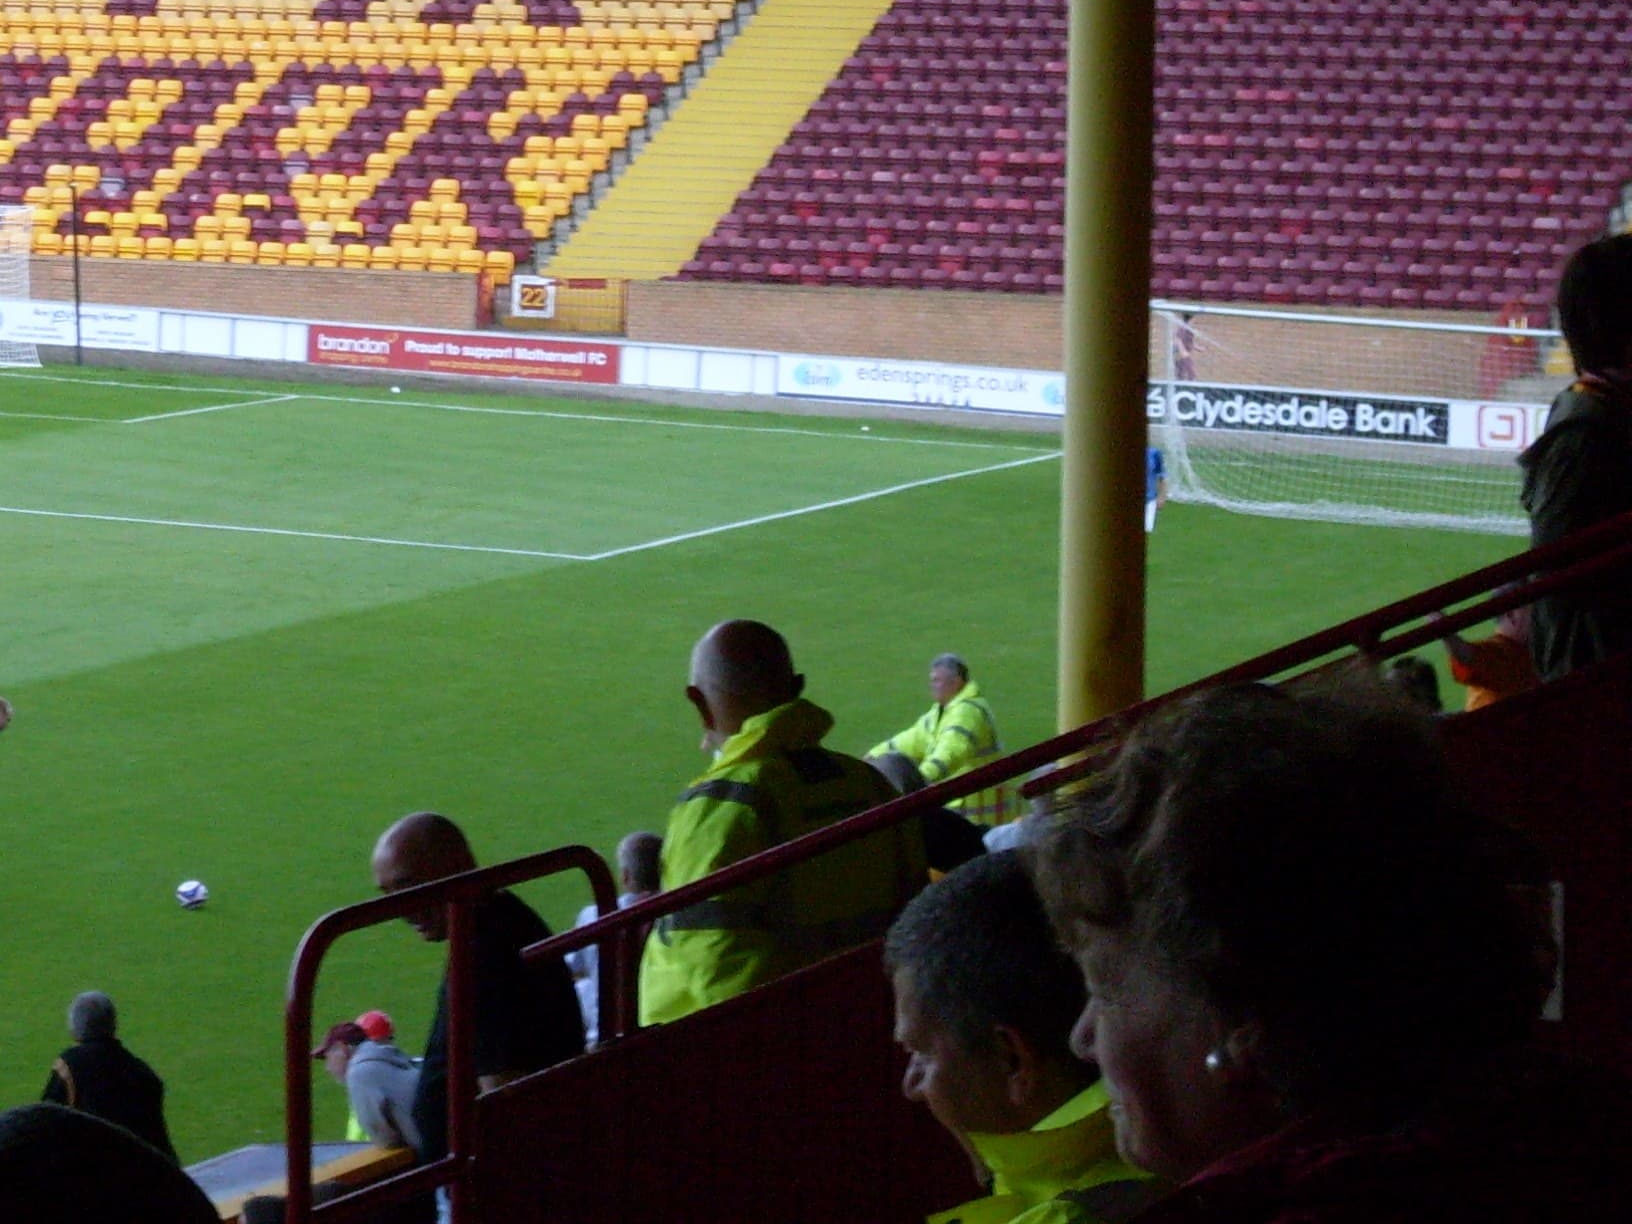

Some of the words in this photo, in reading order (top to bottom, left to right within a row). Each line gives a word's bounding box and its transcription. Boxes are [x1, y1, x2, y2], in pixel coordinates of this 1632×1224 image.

[521, 286, 547, 308] 22
[317, 333, 391, 355] brandon
[404, 339, 444, 355] Proud
[446, 342, 460, 356] to
[461, 344, 513, 362] support
[587, 349, 608, 366] FC
[1174, 388, 1350, 433] Clydesdale
[1355, 402, 1437, 437] Bank
